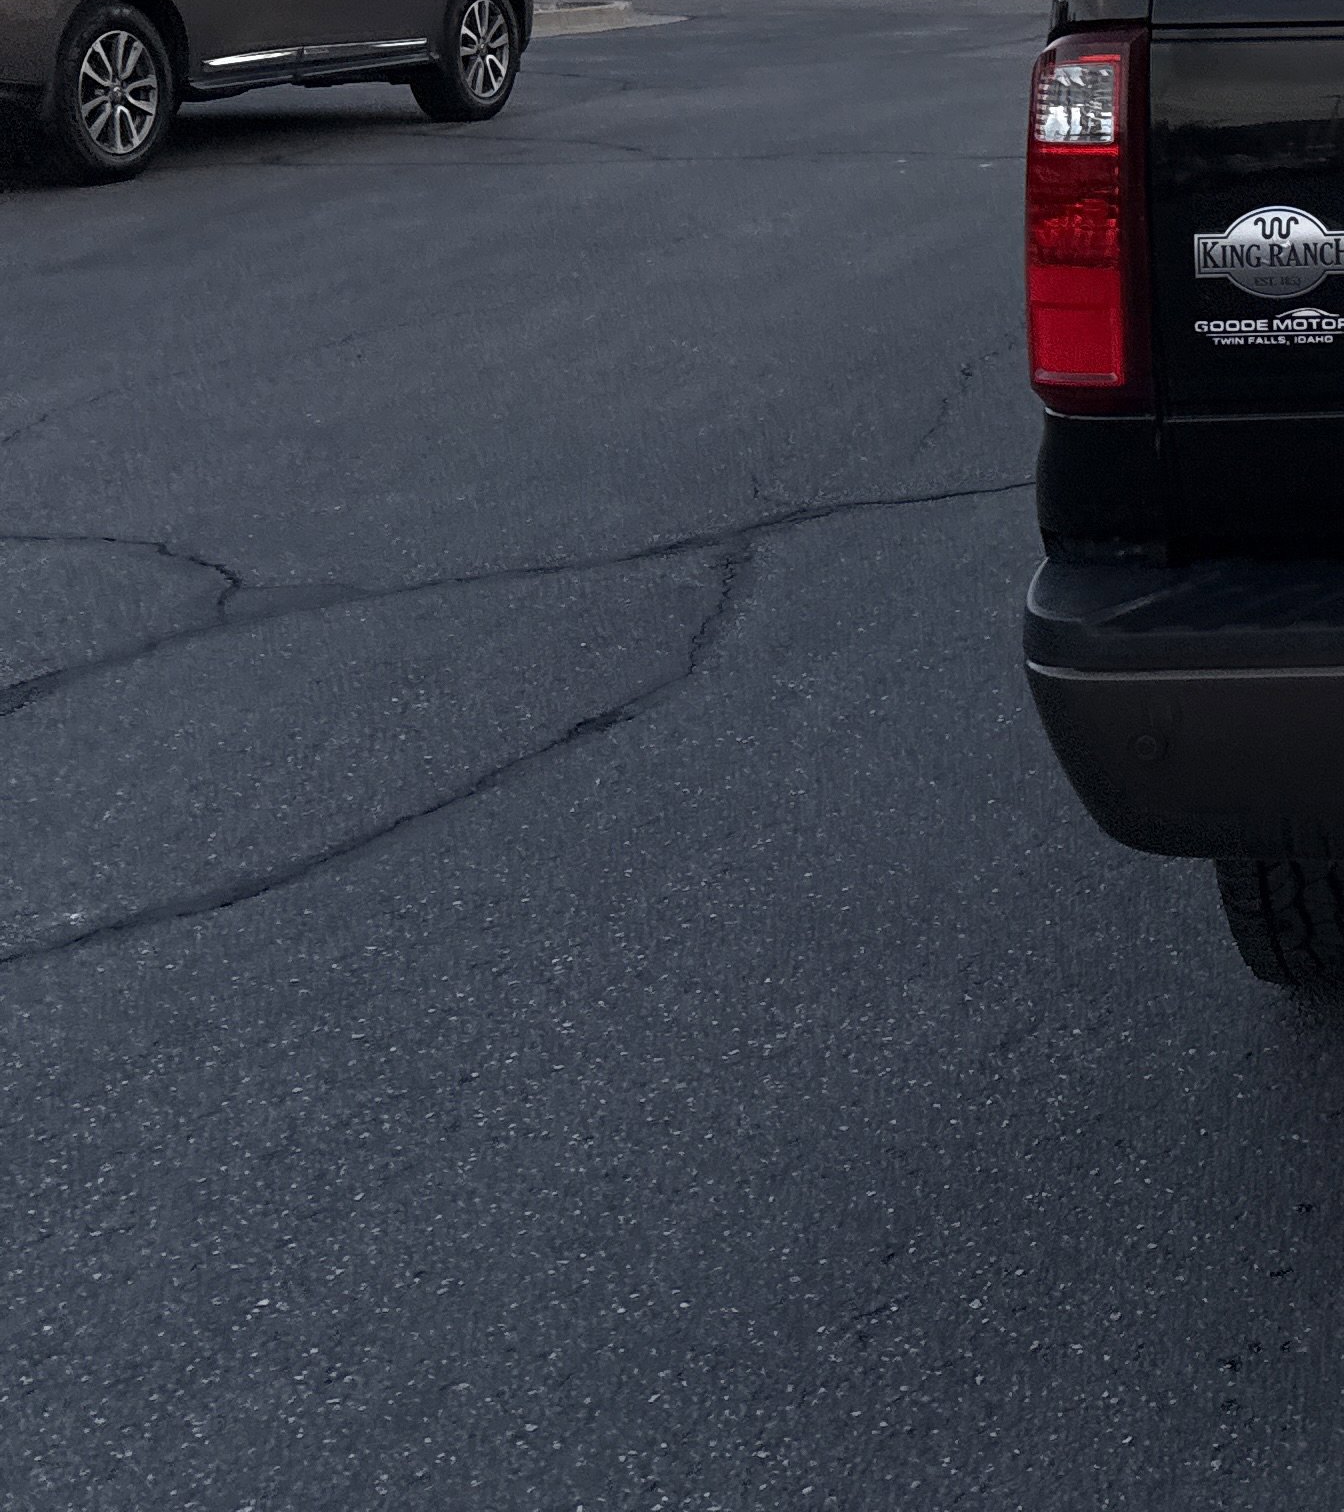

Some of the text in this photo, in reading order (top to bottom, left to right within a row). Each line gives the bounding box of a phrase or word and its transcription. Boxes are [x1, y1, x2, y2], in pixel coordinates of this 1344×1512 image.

[1201, 241, 1262, 269] KING
[1194, 319, 1269, 332] GOODE
[1212, 335, 1334, 346] TWIN FALLS, IDAHO
